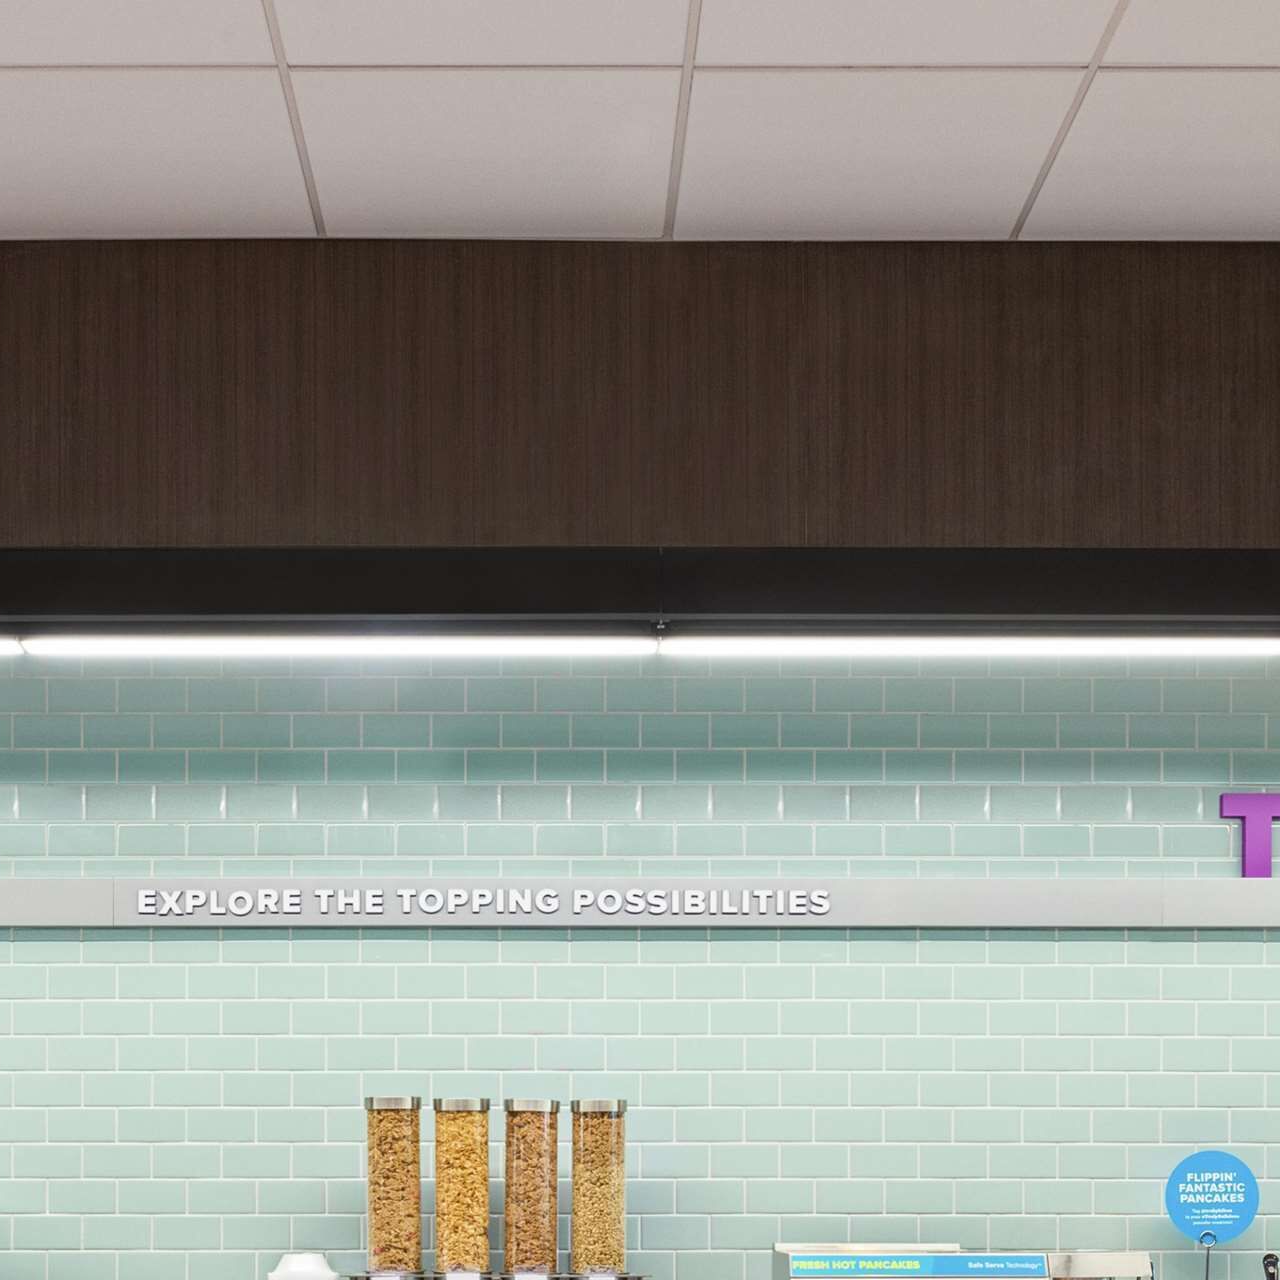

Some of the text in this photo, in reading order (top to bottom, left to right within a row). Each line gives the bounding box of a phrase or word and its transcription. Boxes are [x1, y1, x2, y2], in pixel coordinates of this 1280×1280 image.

[137, 889, 831, 916] EXPLORE THE TOPPING POSSIBILITIES
[1186, 1172, 1238, 1182] FLIPPIN'
[1178, 1182, 1246, 1193] FANTASTIC
[1180, 1193, 1246, 1203] PANCAKES
[792, 1260, 920, 1269] FRESH HOT PANCAKES
